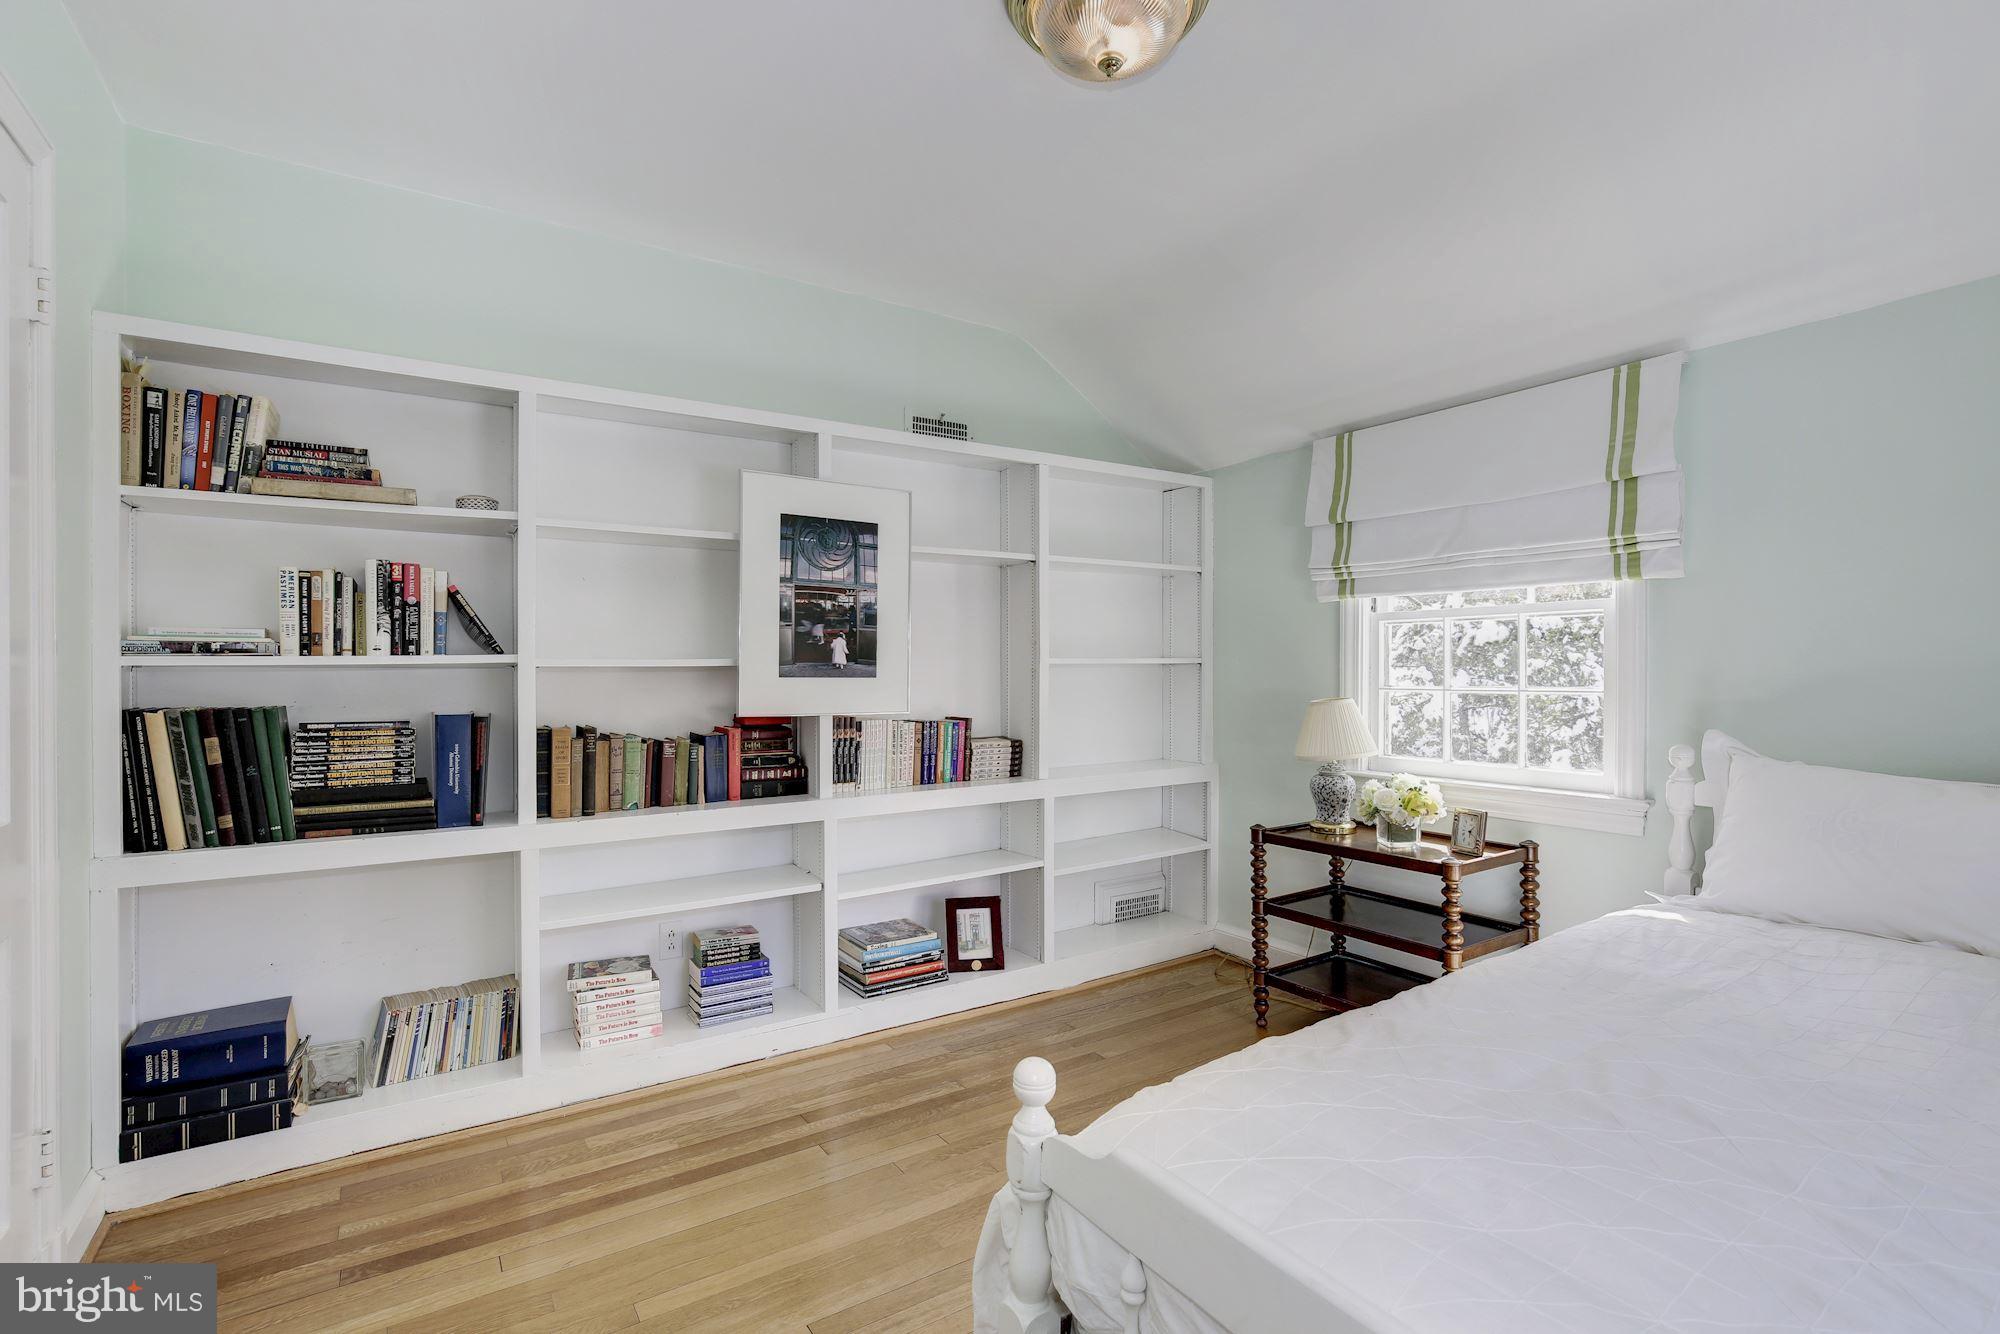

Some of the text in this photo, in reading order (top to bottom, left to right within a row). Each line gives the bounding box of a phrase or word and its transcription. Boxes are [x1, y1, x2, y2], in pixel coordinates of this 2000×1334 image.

[122, 387, 131, 433] BOXING
[187, 394, 198, 406] ONE
[228, 430, 242, 471] CORNER
[292, 450, 325, 459] MUSIAL
[290, 464, 302, 472] WAS
[410, 607, 418, 640] GAME TIME
[161, 1049, 169, 1082] UNABRIDGED
[171, 1049, 179, 1079] DICTIONARY
